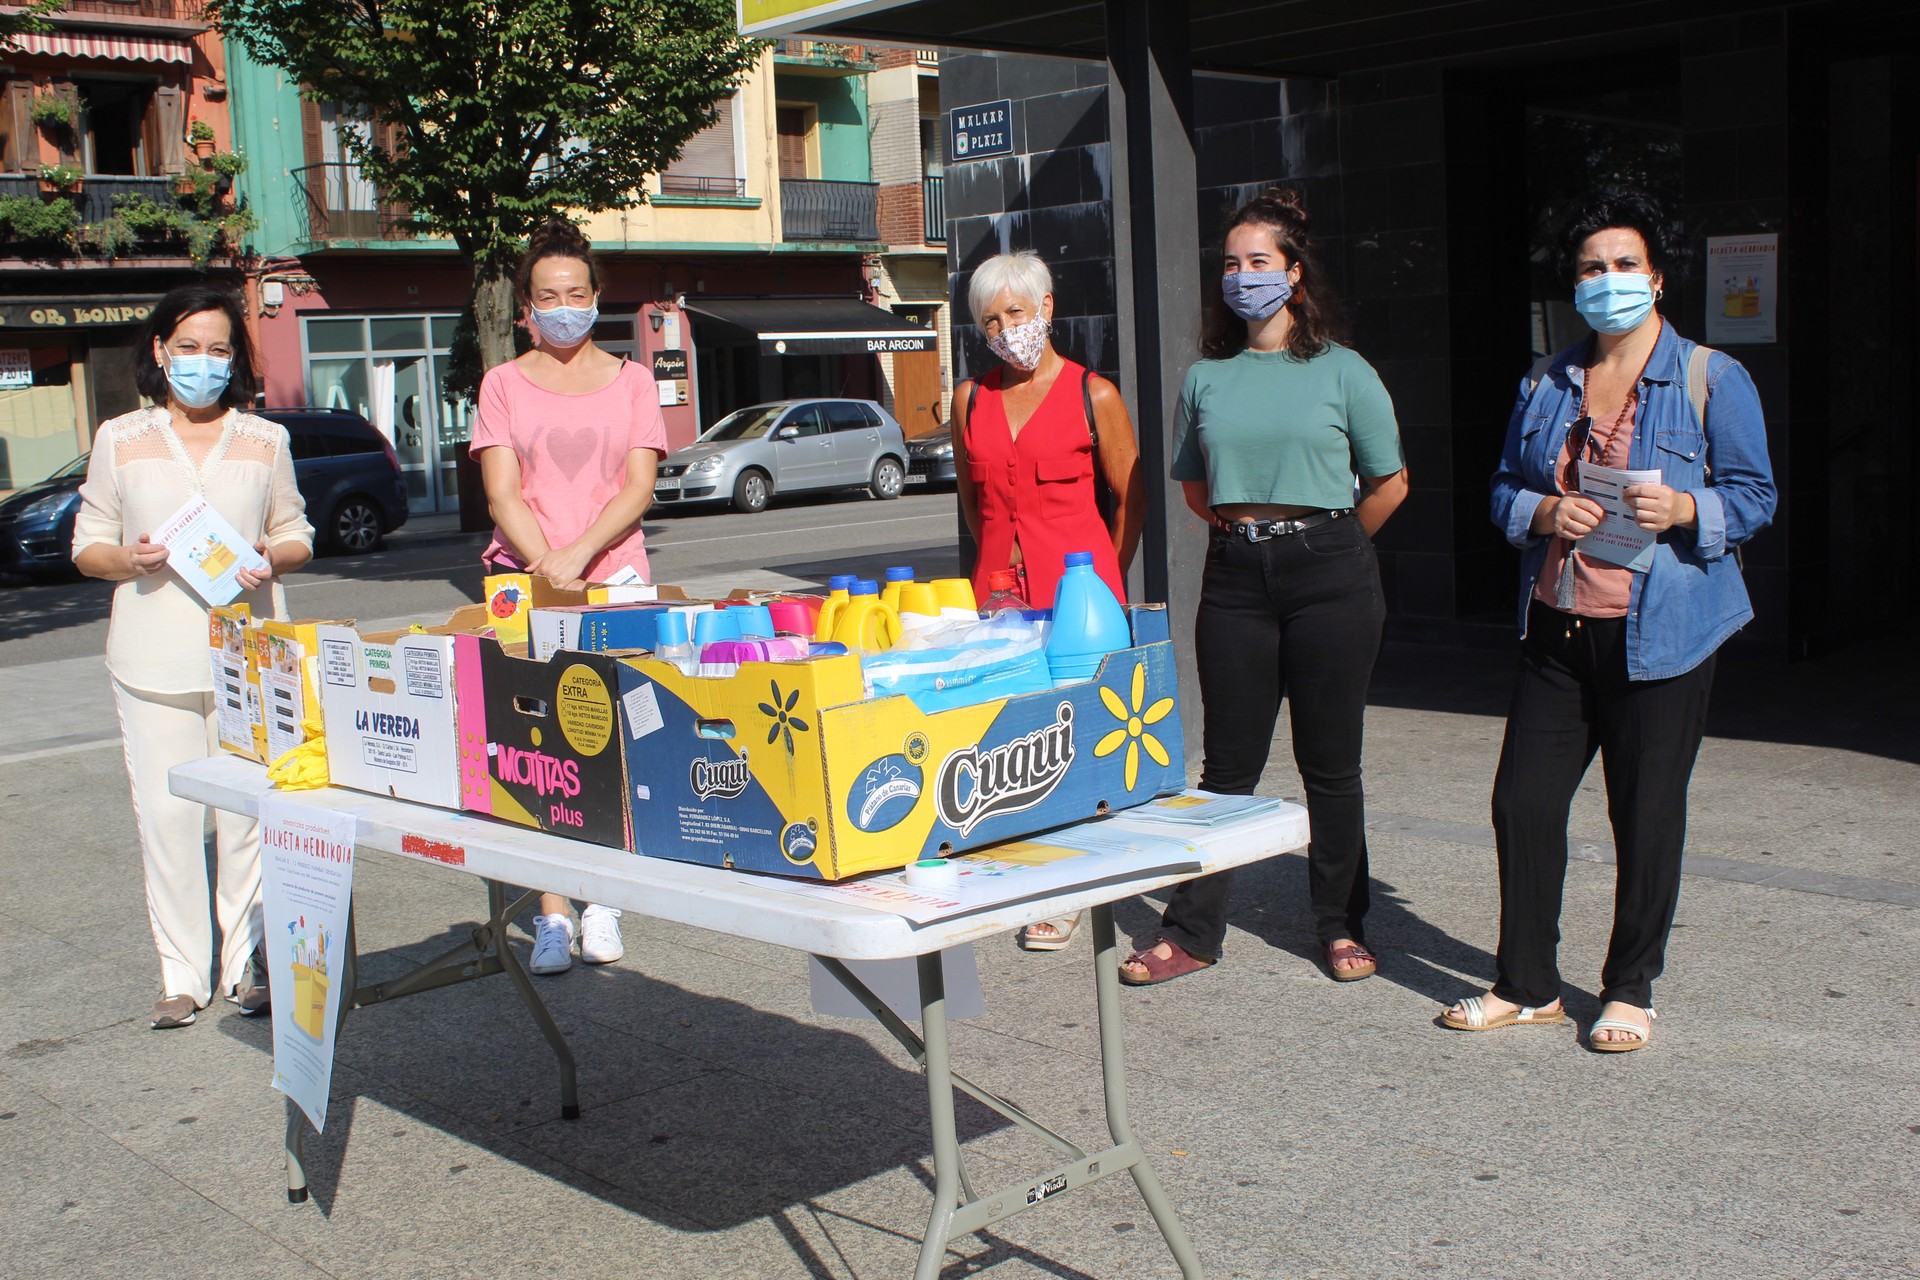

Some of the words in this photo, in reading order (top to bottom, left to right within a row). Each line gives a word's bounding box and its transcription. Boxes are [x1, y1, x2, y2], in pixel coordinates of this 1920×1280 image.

[958, 110, 1004, 129] MALKAR
[972, 133, 1003, 149] PLAZA
[30, 308, 67, 326] OR
[73, 305, 155, 324] KONPO
[867, 340, 887, 350] BAR
[888, 340, 924, 350] ARGOIN
[654, 356, 684, 371] Argoin
[369, 660, 390, 670] PRIMERA
[562, 685, 588, 698] EXTRA
[572, 677, 601, 687] CATEGORÍA
[356, 710, 369, 731] LA
[372, 712, 420, 740] VEREDA
[690, 746, 750, 800] Cuqui
[936, 702, 1075, 834] Cuqui
[865, 794, 882, 815] Plátano
[888, 783, 911, 793] Canarias
[550, 802, 583, 827] plus
[750, 828, 772, 836] BARCELONA
[264, 826, 300, 851] BILKETA
[304, 837, 351, 864] HERRIKOIA
